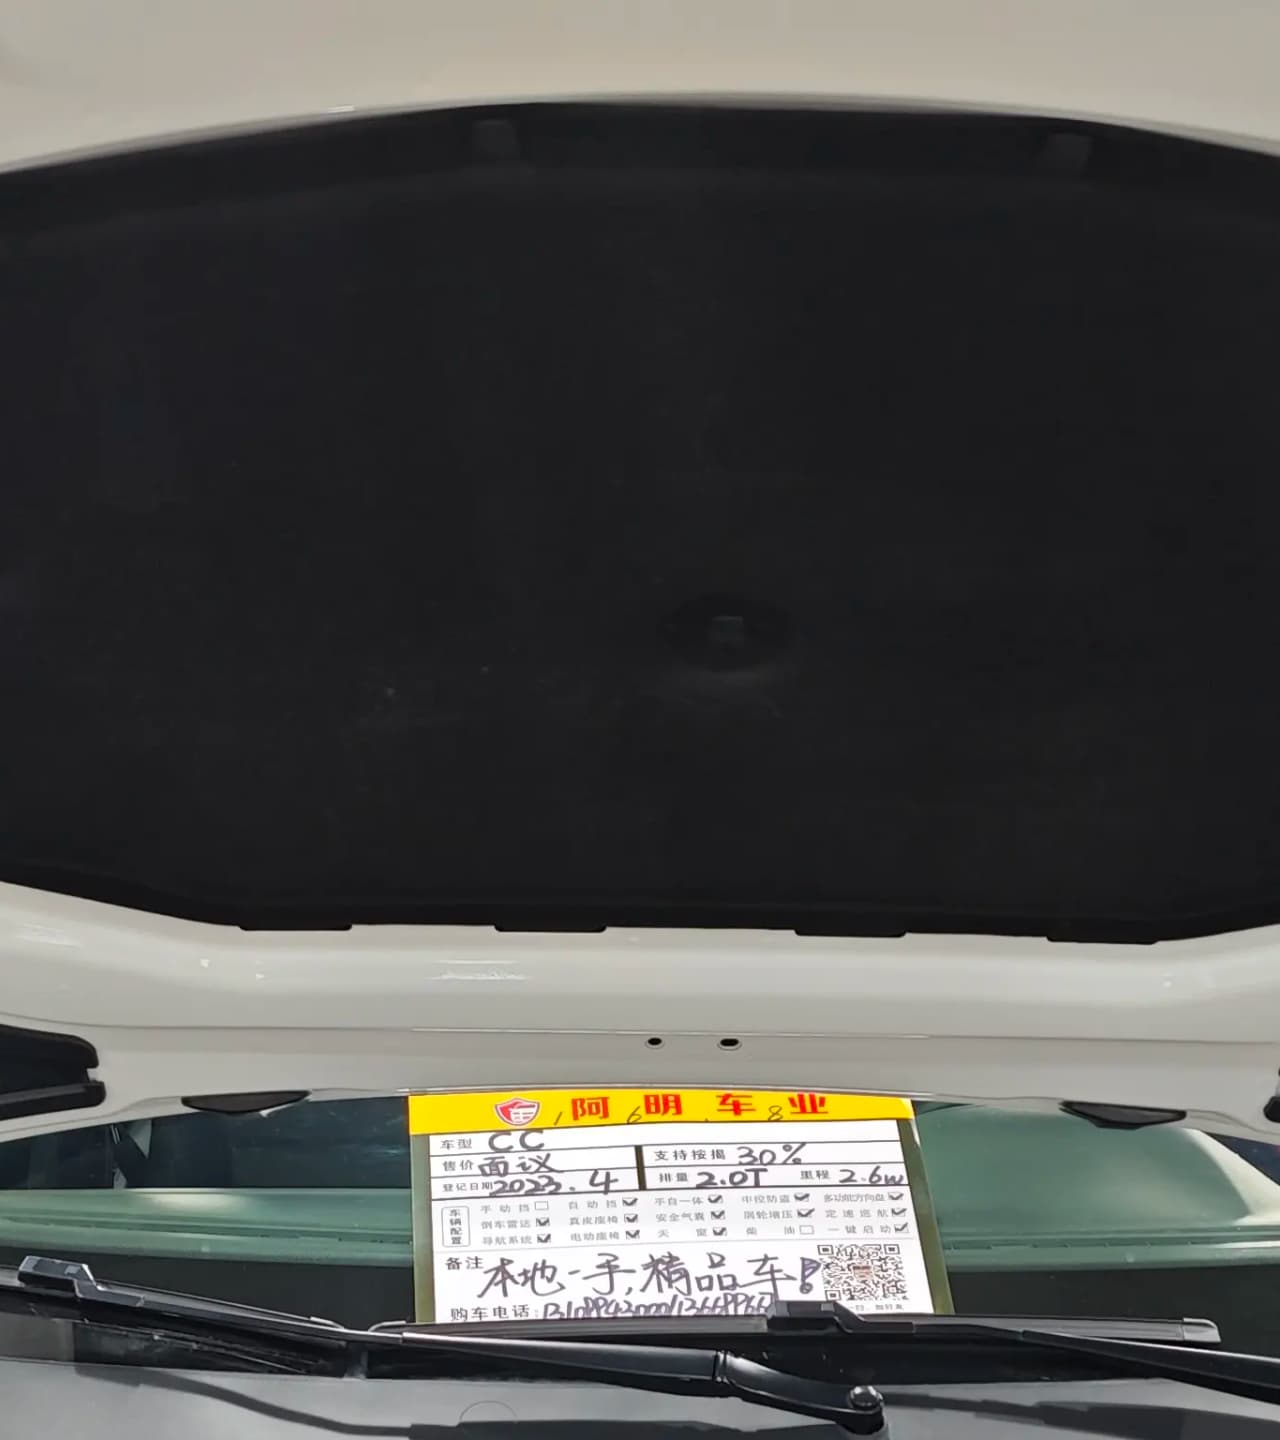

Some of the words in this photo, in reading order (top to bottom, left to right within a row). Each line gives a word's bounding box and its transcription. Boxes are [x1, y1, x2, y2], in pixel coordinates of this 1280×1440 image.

[571, 1093, 828, 1121] 阿明车业
[441, 1138, 472, 1150] 车型
[488, 1130, 545, 1152] CC
[654, 1150, 726, 1161] 支持按揭
[737, 1142, 806, 1166] 30%
[442, 1160, 475, 1172] 售价
[478, 1153, 563, 1177] 面议
[800, 1170, 829, 1180] 里程
[442, 1182, 493, 1192] 登记日期
[659, 1172, 688, 1183] 排量
[696, 1168, 768, 1188] 2.0T
[444, 1256, 484, 1270] 备注
